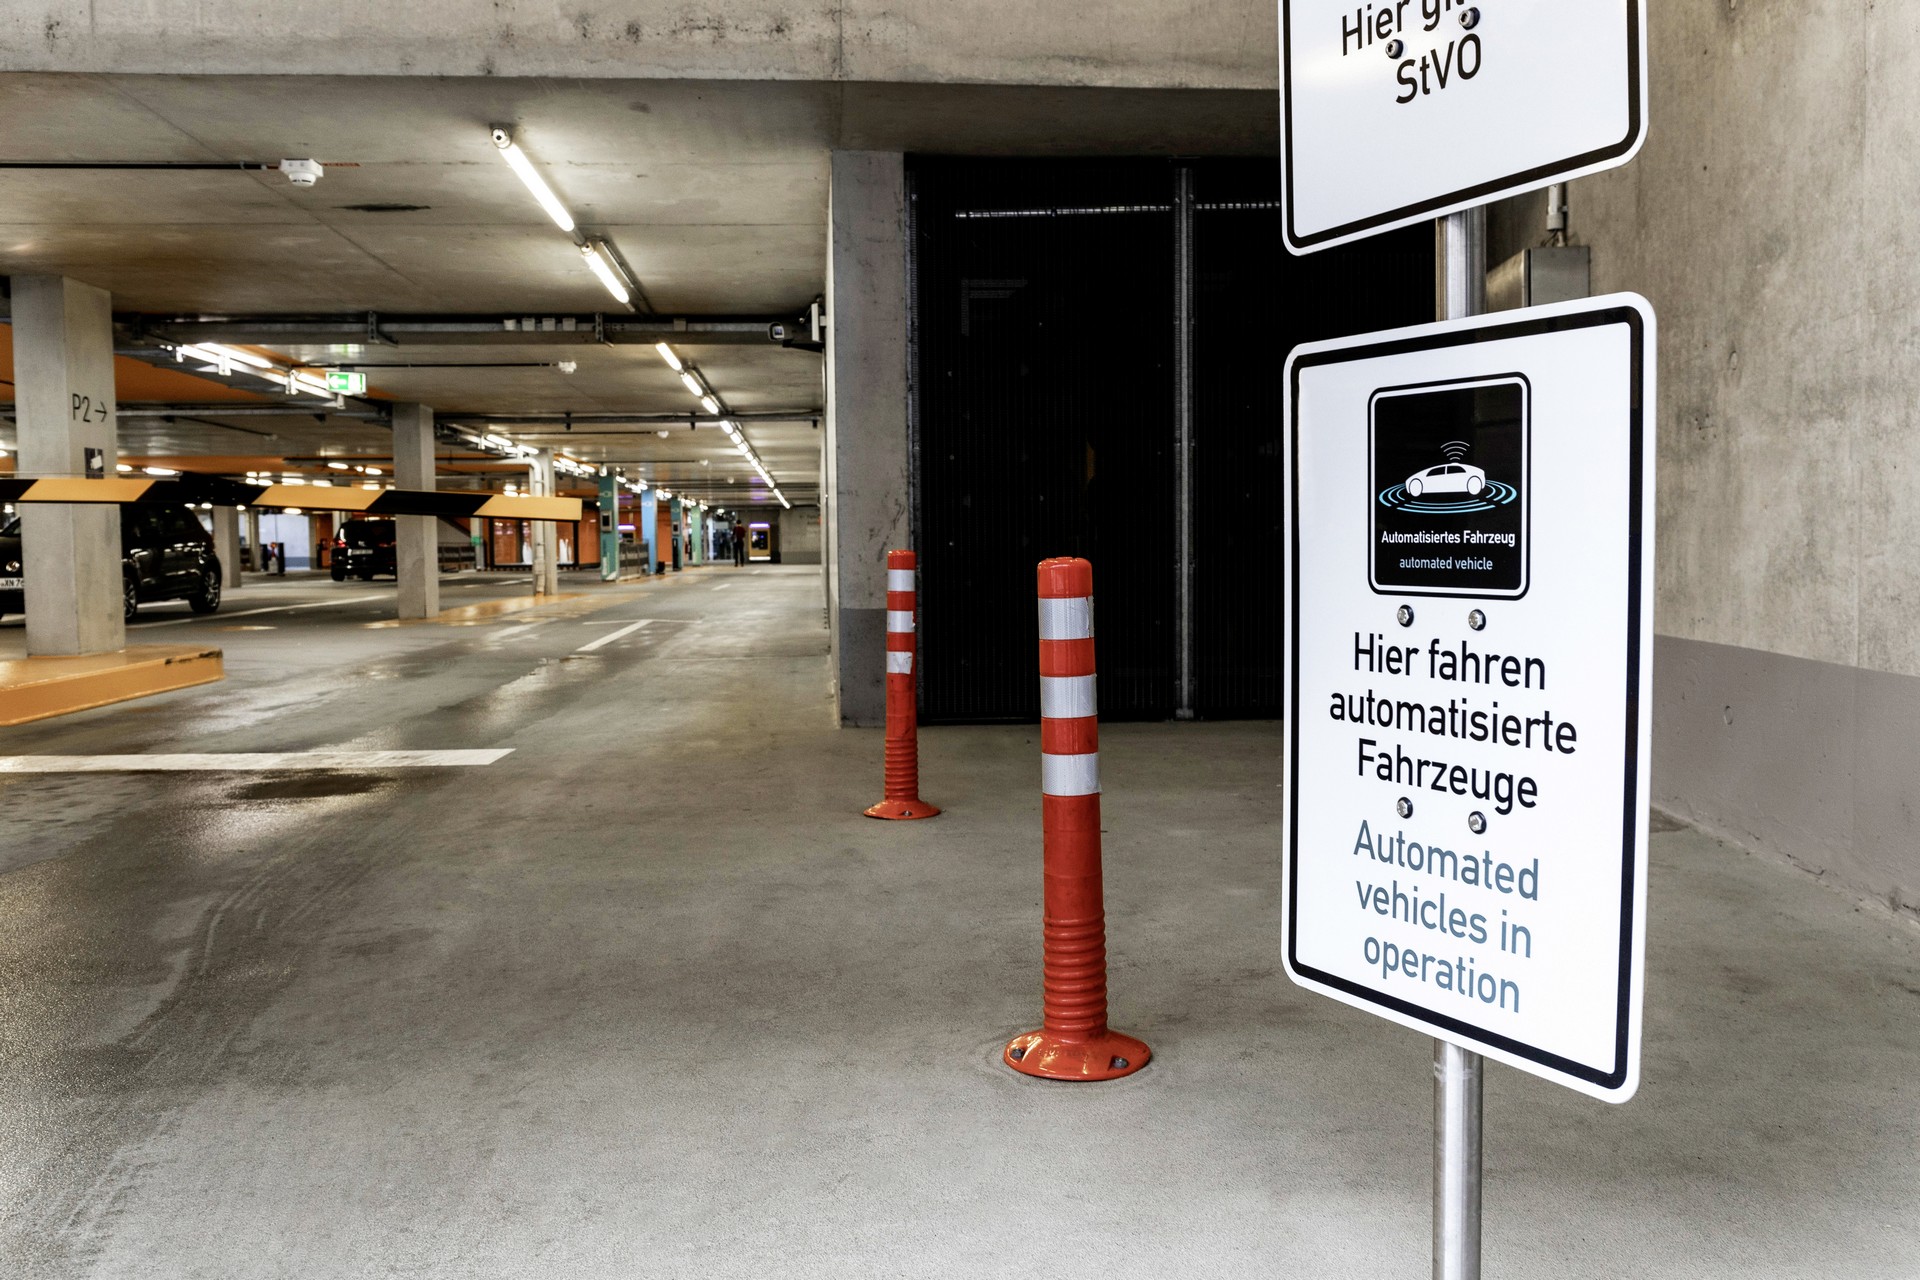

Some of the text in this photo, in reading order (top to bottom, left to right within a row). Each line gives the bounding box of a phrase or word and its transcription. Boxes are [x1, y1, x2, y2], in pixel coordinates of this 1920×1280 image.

[1342, 0, 1410, 56] Hier
[1396, 33, 1481, 104] StVO
[72, 393, 91, 422] P2
[1381, 530, 1516, 547] Automatisiertes Fahrzeug
[1399, 557, 1493, 570] automated vehicle
[1355, 632, 1546, 690] Hier fahren
[1330, 689, 1577, 754] automatisierte
[1358, 738, 1538, 815] Fahrzeuge
[1354, 820, 1539, 901] Automated
[1356, 880, 1531, 958] vehicles in
[1364, 937, 1520, 1013] operation
